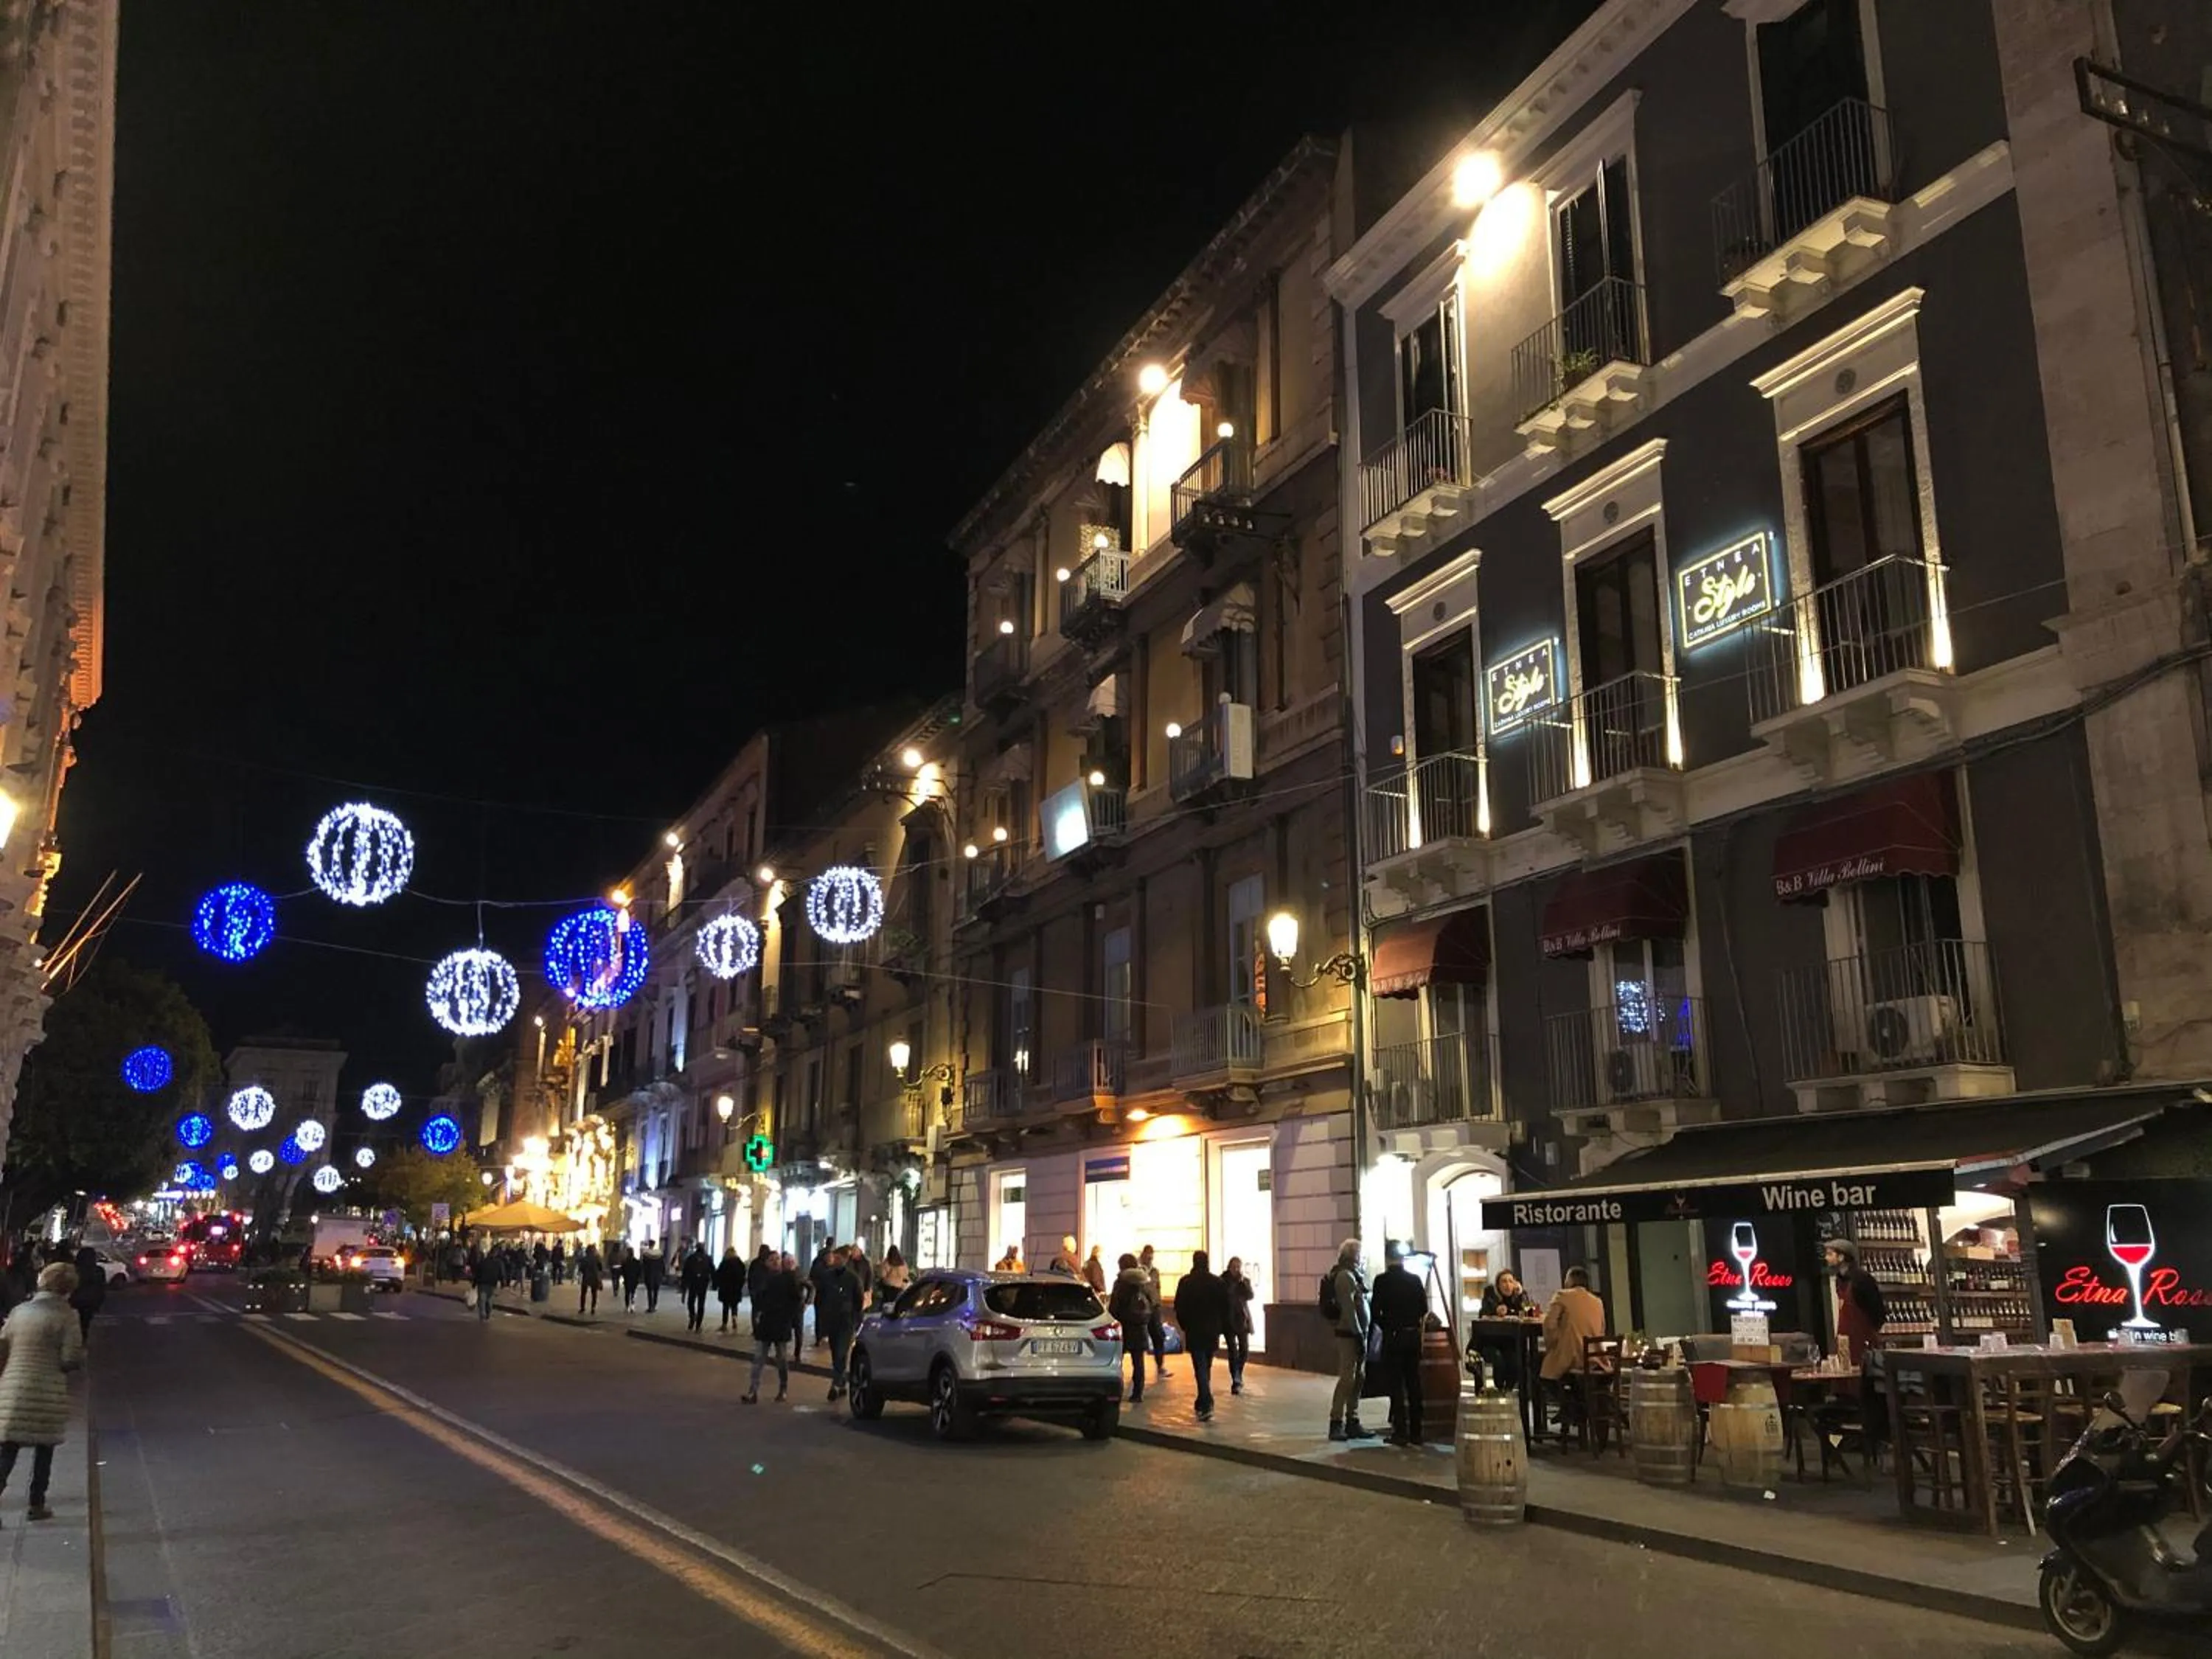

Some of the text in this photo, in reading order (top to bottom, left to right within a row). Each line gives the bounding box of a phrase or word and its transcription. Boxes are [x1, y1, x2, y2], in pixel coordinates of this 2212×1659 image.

[1684, 543, 1760, 587] ETNEA
[1694, 564, 1756, 624] Style
[1492, 648, 1548, 682] ETNEA
[1498, 665, 1545, 714] Style
[1775, 857, 1885, 896] B&B Villa Bellini
[1513, 1198, 1622, 1225] Ristorante
[1761, 1180, 1877, 1211] Wine bar
[1708, 1261, 1792, 1287] Etna Rosso
[2055, 1266, 2128, 1304] Etna
[2143, 1329, 2167, 1342] wine
